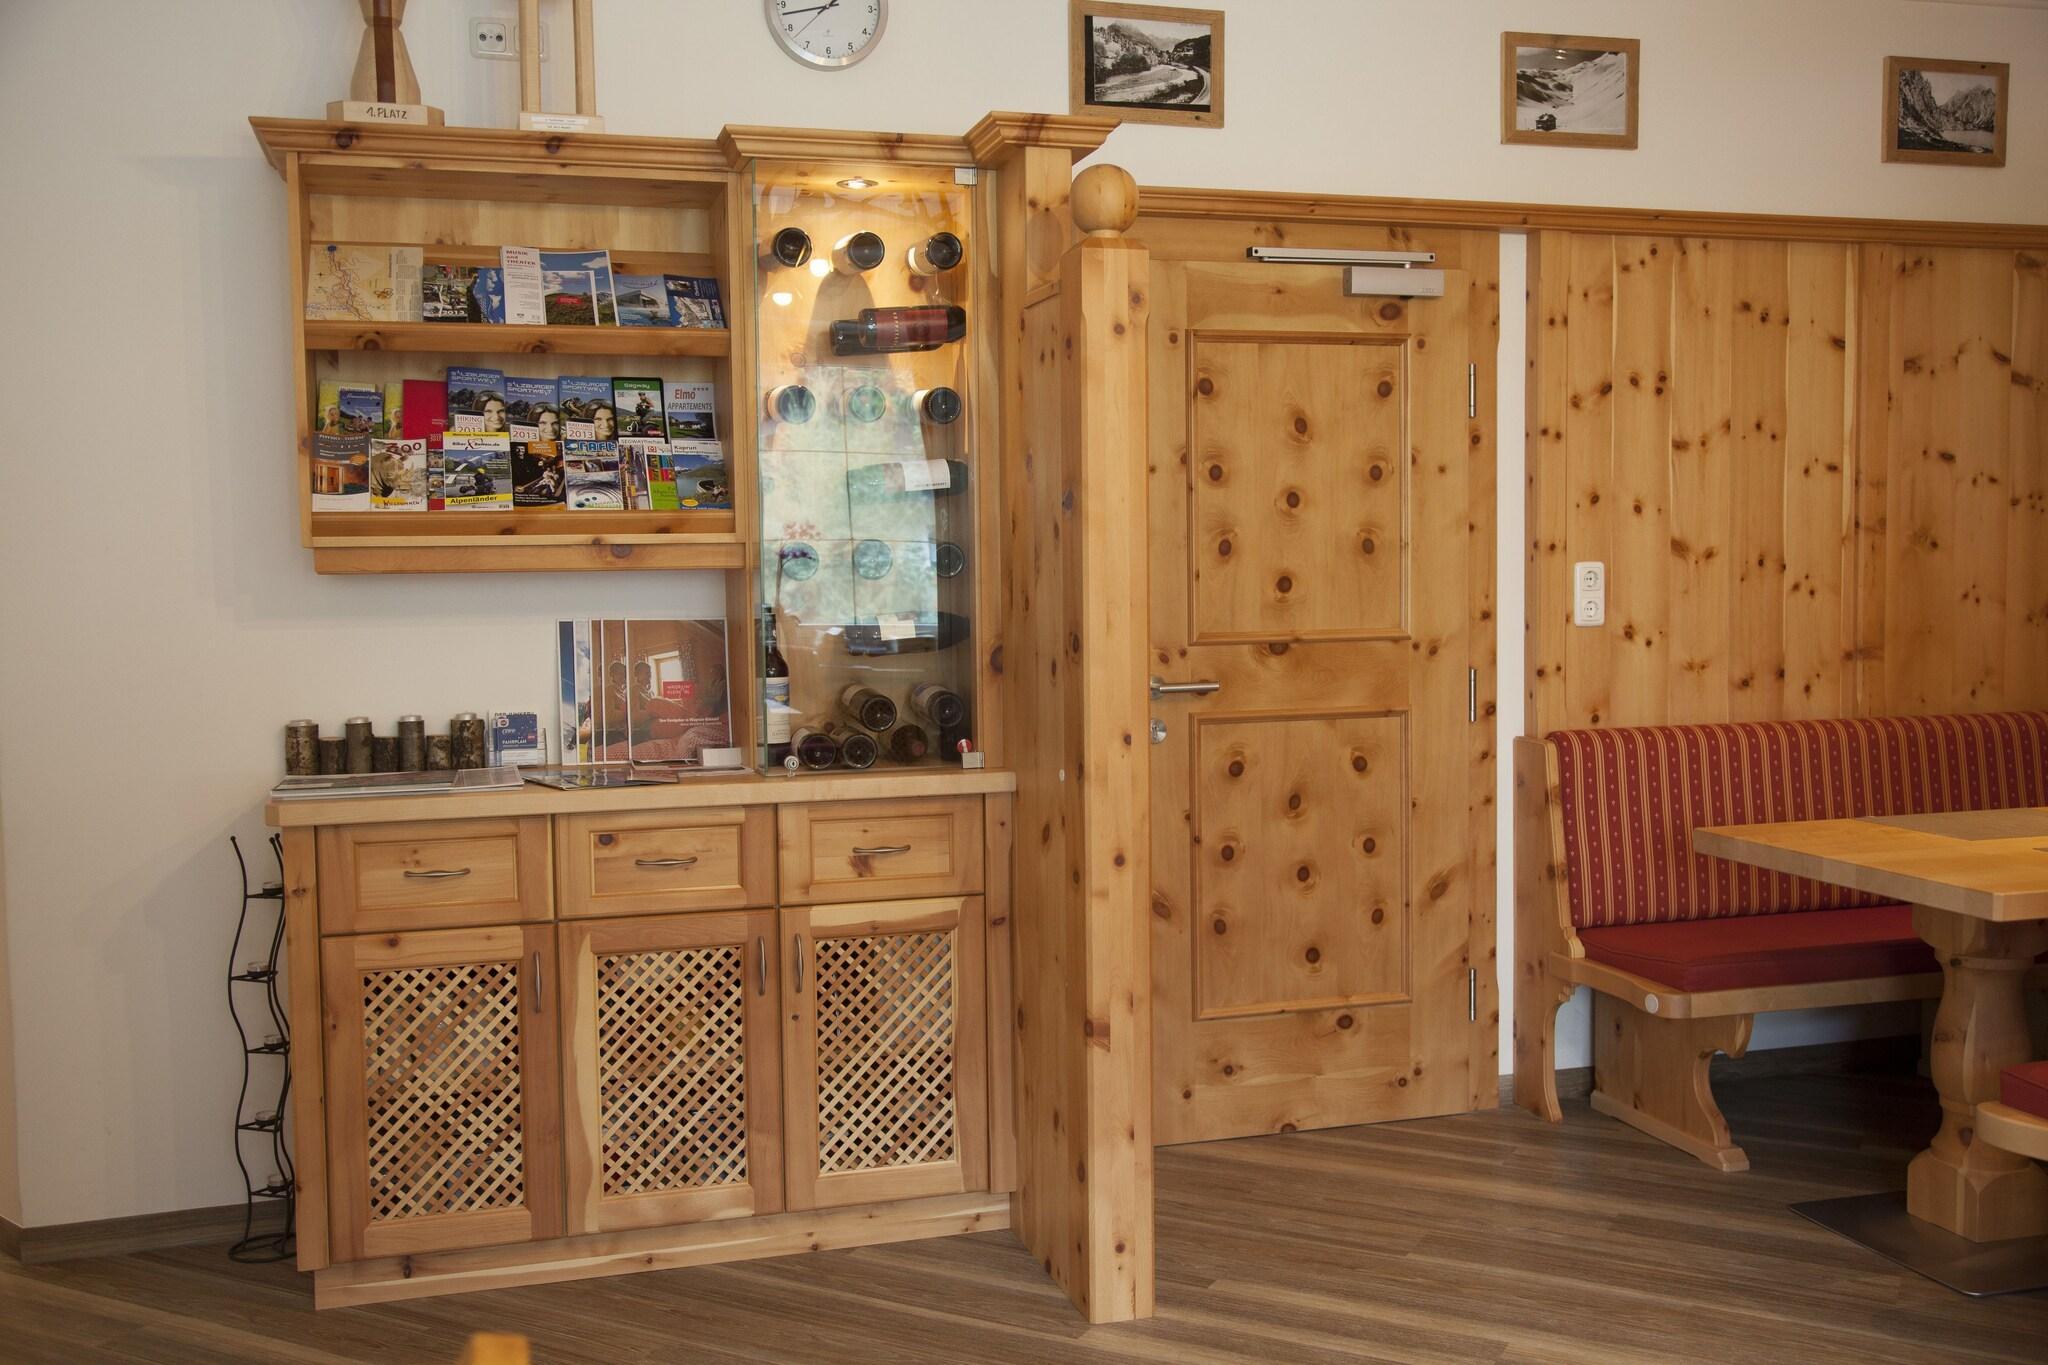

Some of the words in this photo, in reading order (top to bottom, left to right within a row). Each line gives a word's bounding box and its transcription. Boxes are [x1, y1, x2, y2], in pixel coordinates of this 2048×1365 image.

[781, 0, 786, 8] 9
[787, 24, 793, 32] 8
[804, 41, 810, 49] 7
[848, 42, 853, 50] 5
[507, 381, 555, 389] SALZBURGER
[507, 387, 552, 396] SPORTWELT
[674, 388, 696, 400] Elmo
[667, 402, 712, 410] APPARTEMENTS
[513, 431, 537, 439] 2013
[569, 429, 593, 438] 2013
[450, 496, 497, 504] Alpenländer
